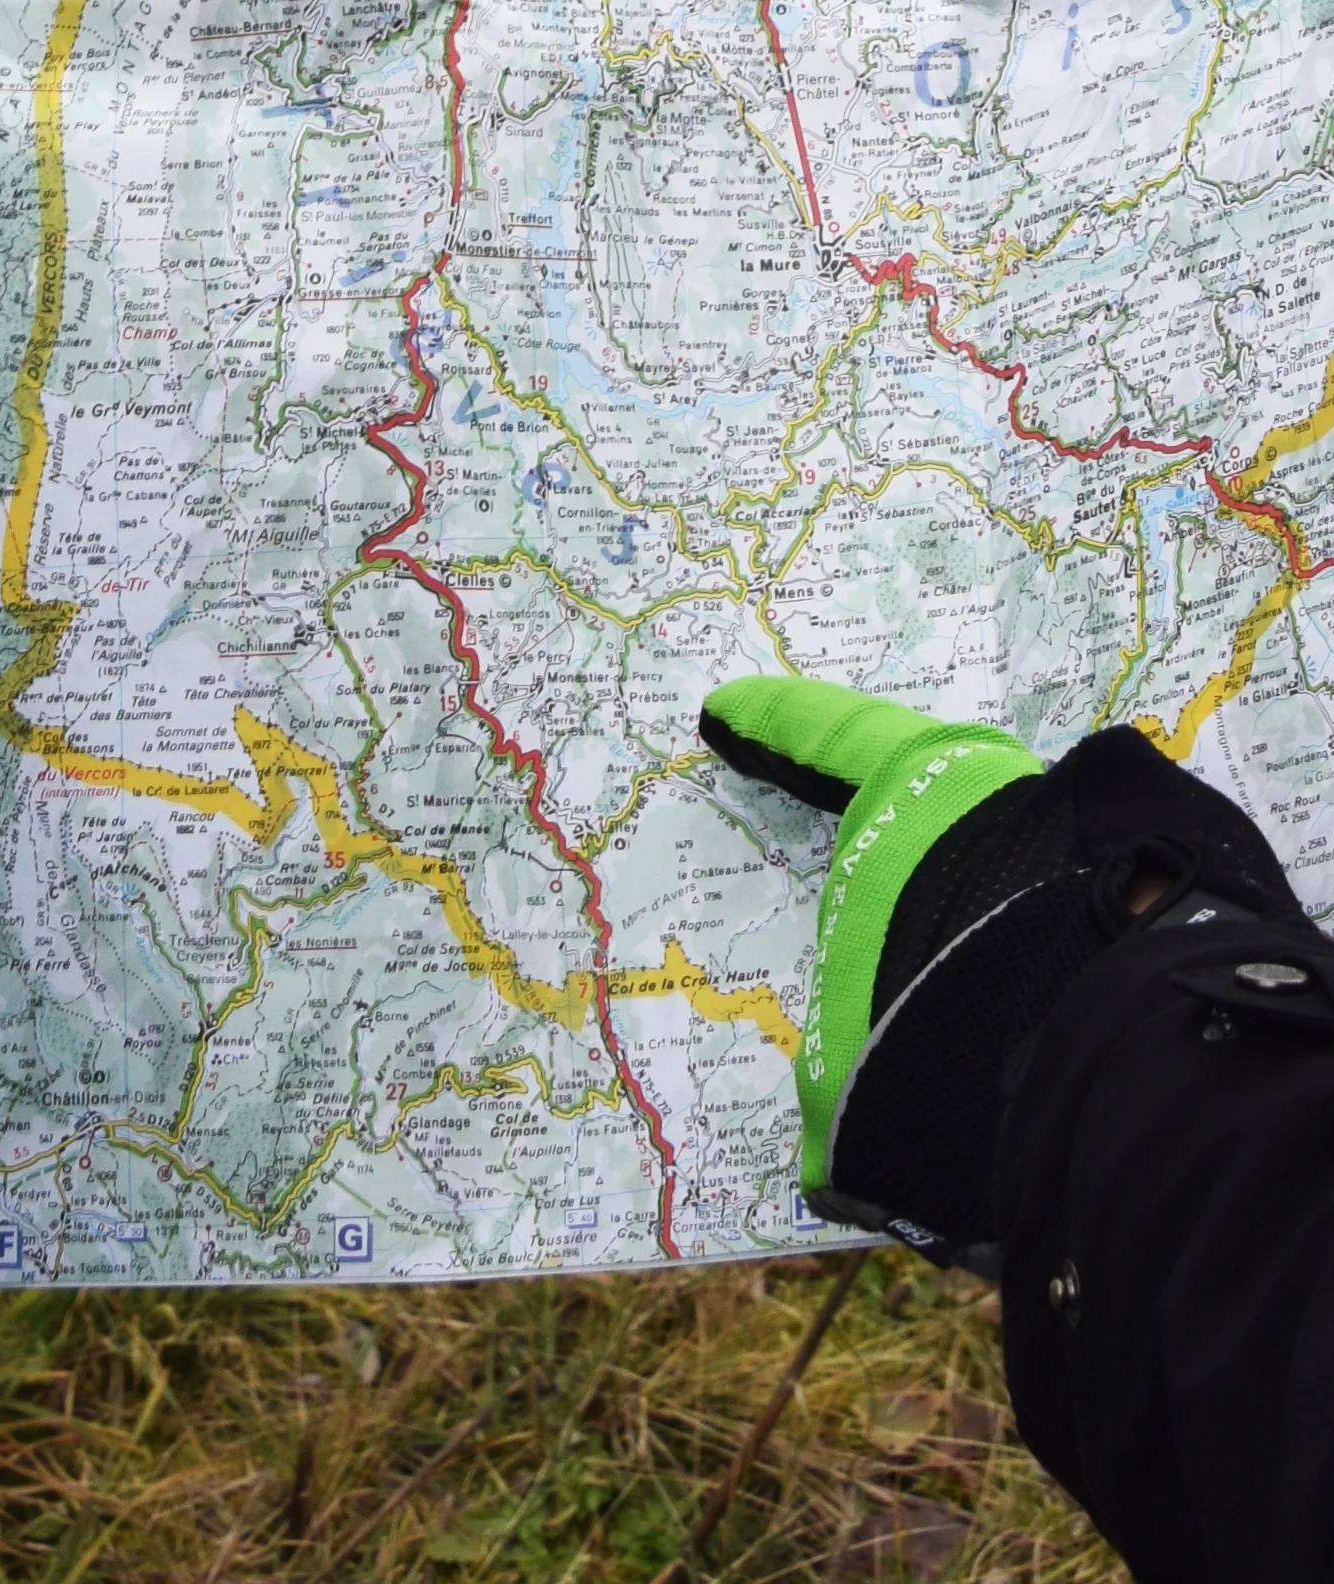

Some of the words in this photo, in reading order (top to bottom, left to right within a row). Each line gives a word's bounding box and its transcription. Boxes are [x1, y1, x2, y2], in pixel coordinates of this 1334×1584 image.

[190, 20, 292, 38] Château-Bernard
[797, 73, 840, 86] Pierre-
[797, 87, 839, 99] Châtel
[508, 213, 553, 224] Treffort
[741, 260, 756, 271] la
[761, 259, 800, 271] Mure
[1198, 249, 1241, 273] Gargas
[699, 300, 759, 312] Prunières
[123, 326, 178, 340] Champ
[27, 349, 46, 380] DU
[442, 363, 492, 375] Roissard
[529, 375, 548, 390] 19
[71, 406, 87, 418] le
[125, 401, 191, 417] Veymont
[1024, 400, 1040, 419] 25
[470, 421, 495, 432] Pont
[498, 423, 513, 432] de
[517, 421, 549, 433] Brion
[900, 434, 959, 452] Sébastien
[424, 460, 444, 477] 13
[1222, 454, 1258, 475] Corps
[798, 469, 814, 485] 19
[553, 483, 592, 495] Lavars
[557, 508, 619, 521] Cornillon-
[1073, 503, 1116, 524] Sautet
[929, 518, 982, 532] Cordéac
[258, 529, 320, 543] Aiguille
[128, 577, 149, 591] Tir
[445, 574, 494, 588] Clelles
[775, 584, 813, 599] Mens
[650, 623, 668, 638] 14
[218, 642, 298, 653] Chichilianne
[440, 695, 456, 712] 15
[629, 690, 678, 703] Prébois
[64, 767, 127, 780] Vercors
[324, 851, 346, 867] 35
[804, 802, 897, 1082] ADVENTURES
[177, 951, 226, 964] Creyers
[609, 983, 634, 995] Col
[680, 972, 720, 990] Croix
[725, 967, 770, 982] Haute
[579, 982, 587, 999] 7
[387, 1082, 407, 1100] 27
[469, 1099, 522, 1111] Grimone
[409, 1116, 470, 1130] Glandage
[496, 1112, 516, 1125] Col
[522, 1112, 538, 1124] de
[490, 1125, 547, 1139] Grimone
[339, 1226, 362, 1250] G
